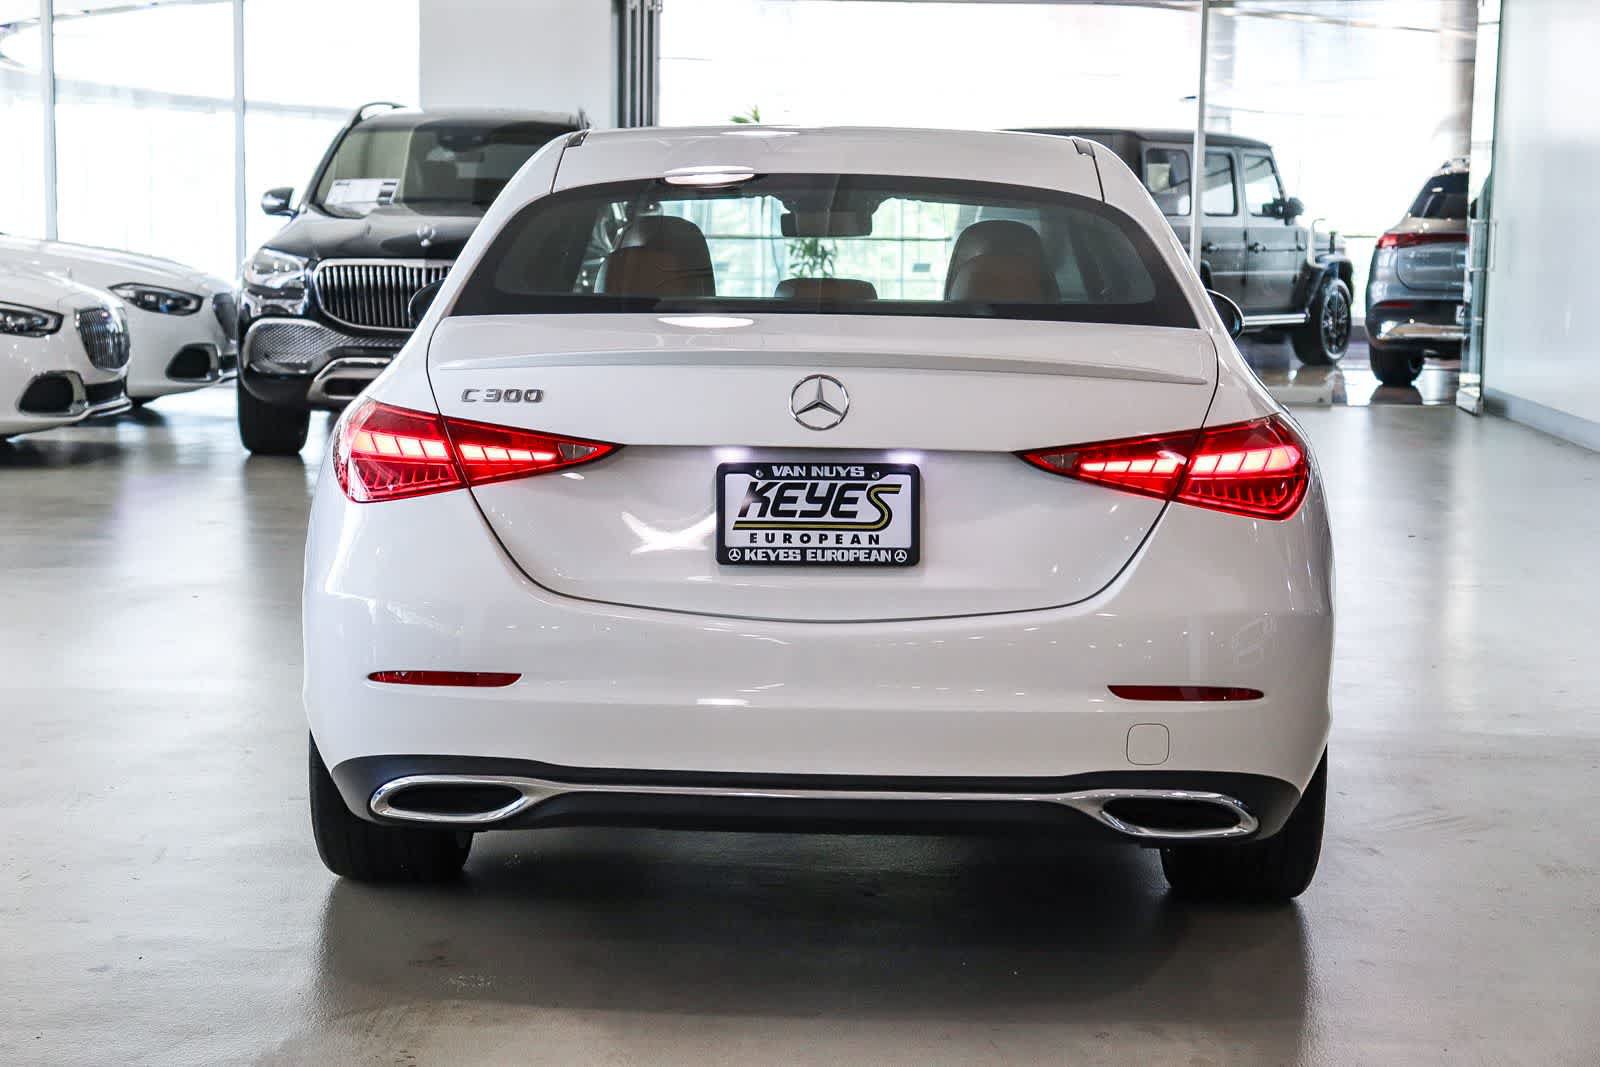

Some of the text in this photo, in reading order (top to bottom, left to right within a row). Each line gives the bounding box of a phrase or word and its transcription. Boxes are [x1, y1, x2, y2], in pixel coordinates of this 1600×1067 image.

[461, 388, 545, 403] C 300
[772, 466, 865, 478] VAN NUYS
[736, 481, 902, 531] KEYES
[750, 533, 880, 545] EUROPEAN
[744, 550, 892, 562] KEYES EUROPEAN
